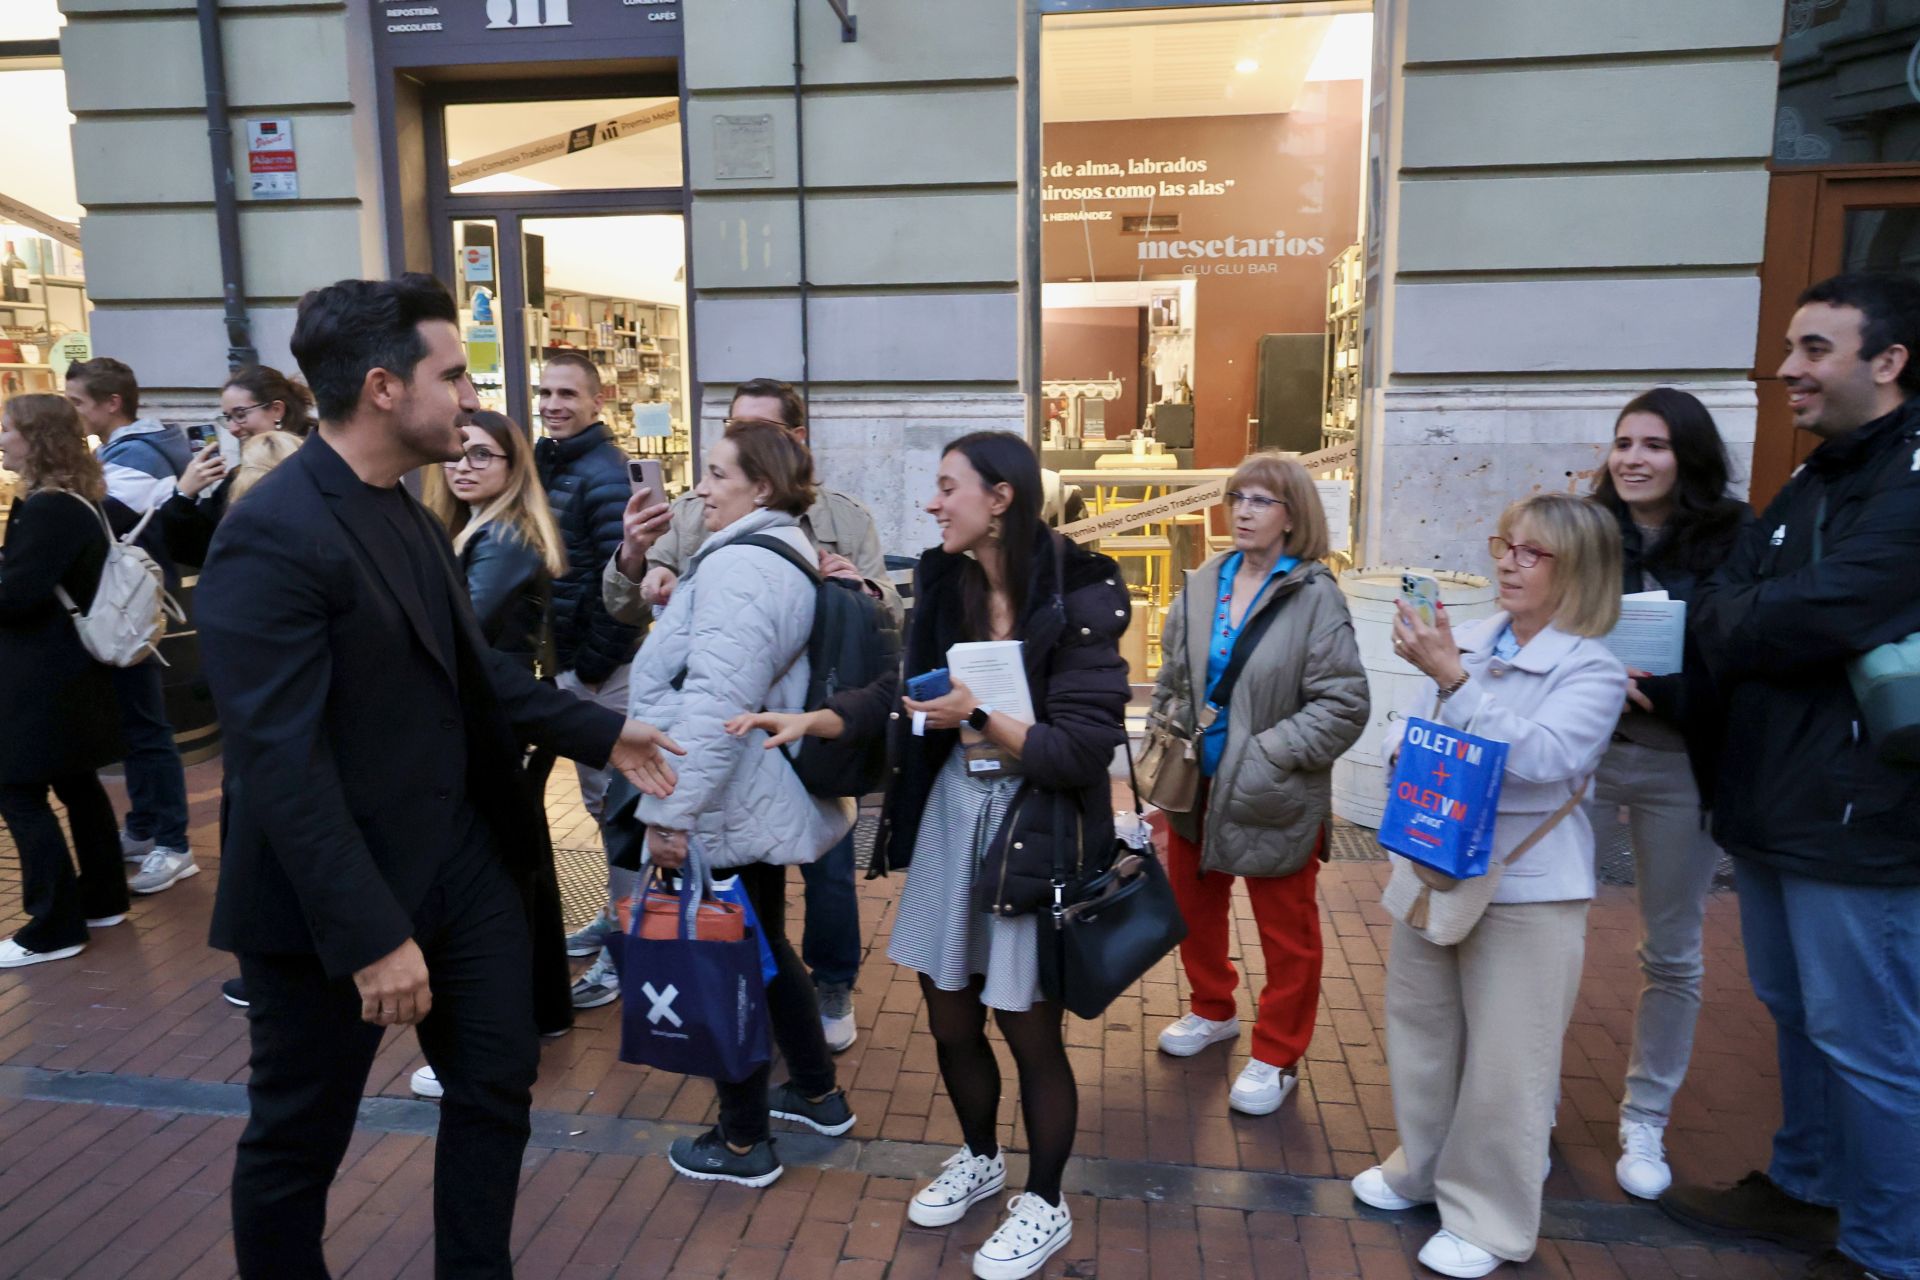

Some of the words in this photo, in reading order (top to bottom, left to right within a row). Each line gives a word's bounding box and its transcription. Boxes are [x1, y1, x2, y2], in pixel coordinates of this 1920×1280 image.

[648, 11, 676, 21] CAFÉS
[387, 22, 443, 33] CHOCOLATES
[252, 155, 293, 165] Alarma
[1050, 161, 1073, 177] de
[1075, 160, 1125, 177] alma,
[1128, 157, 1207, 174] labrados
[1105, 184, 1155, 198] como
[1159, 181, 1185, 196] las
[1050, 210, 1112, 222] HERNÁNDEZ
[1137, 230, 1325, 260] mesetarios
[1182, 264, 1211, 275] GLU
[1215, 264, 1244, 274] GLU
[1247, 263, 1277, 273] BAR
[1320, 452, 1347, 465] Mejor
[1097, 518, 1123, 530] Mejor
[1125, 504, 1169, 522] Comercio
[1170, 488, 1221, 509] Tradicional
